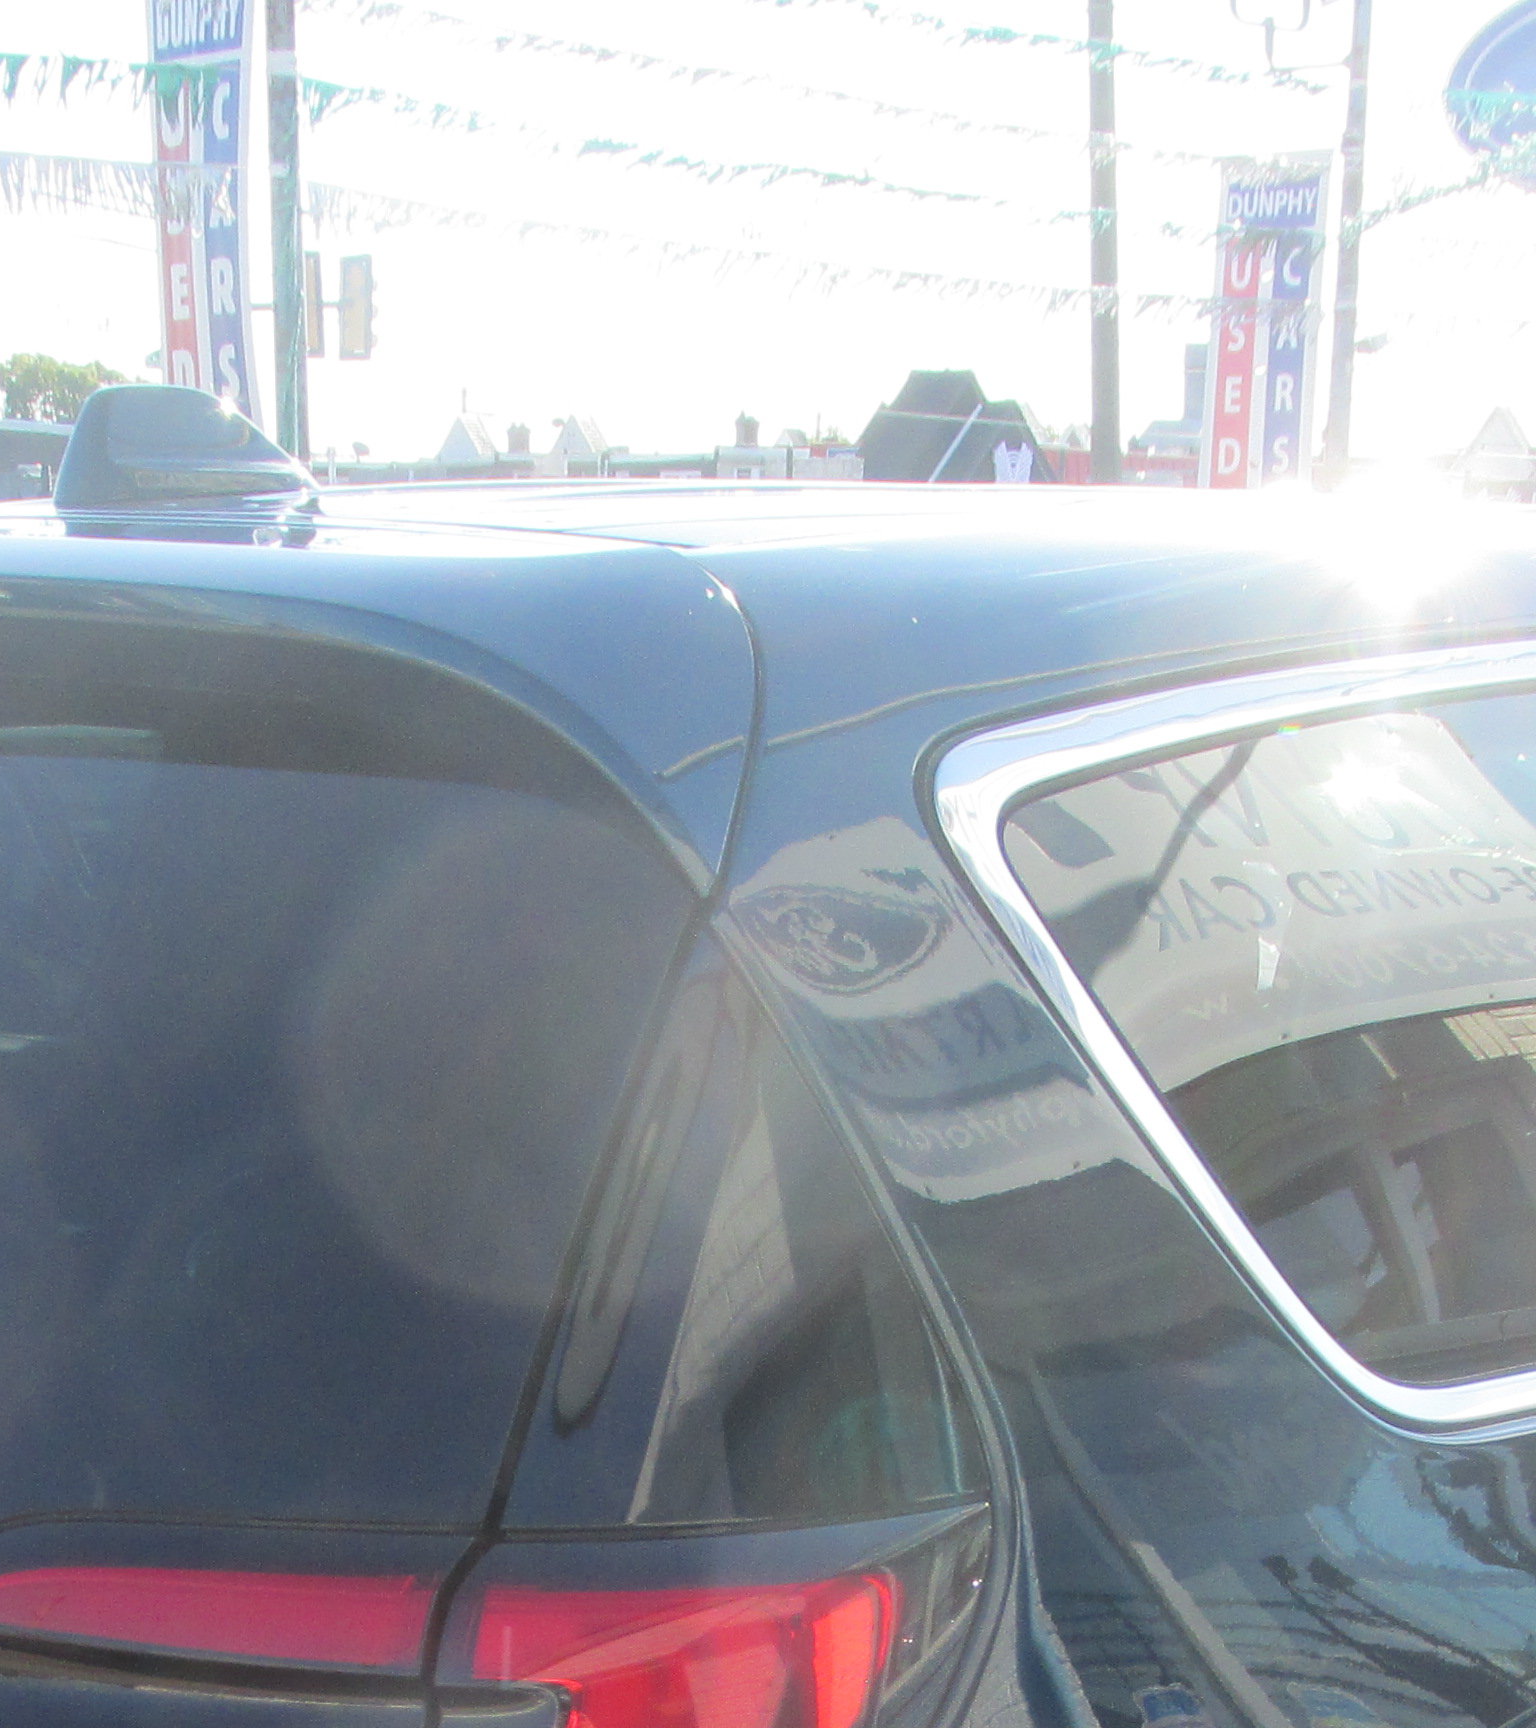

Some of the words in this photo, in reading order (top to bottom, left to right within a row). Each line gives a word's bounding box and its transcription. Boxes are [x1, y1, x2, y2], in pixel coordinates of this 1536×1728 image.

[159, 80, 199, 388] UED
[1227, 187, 1317, 219] DUNPHY
[1216, 247, 1253, 475] USED
[1271, 247, 1303, 474] CARS
